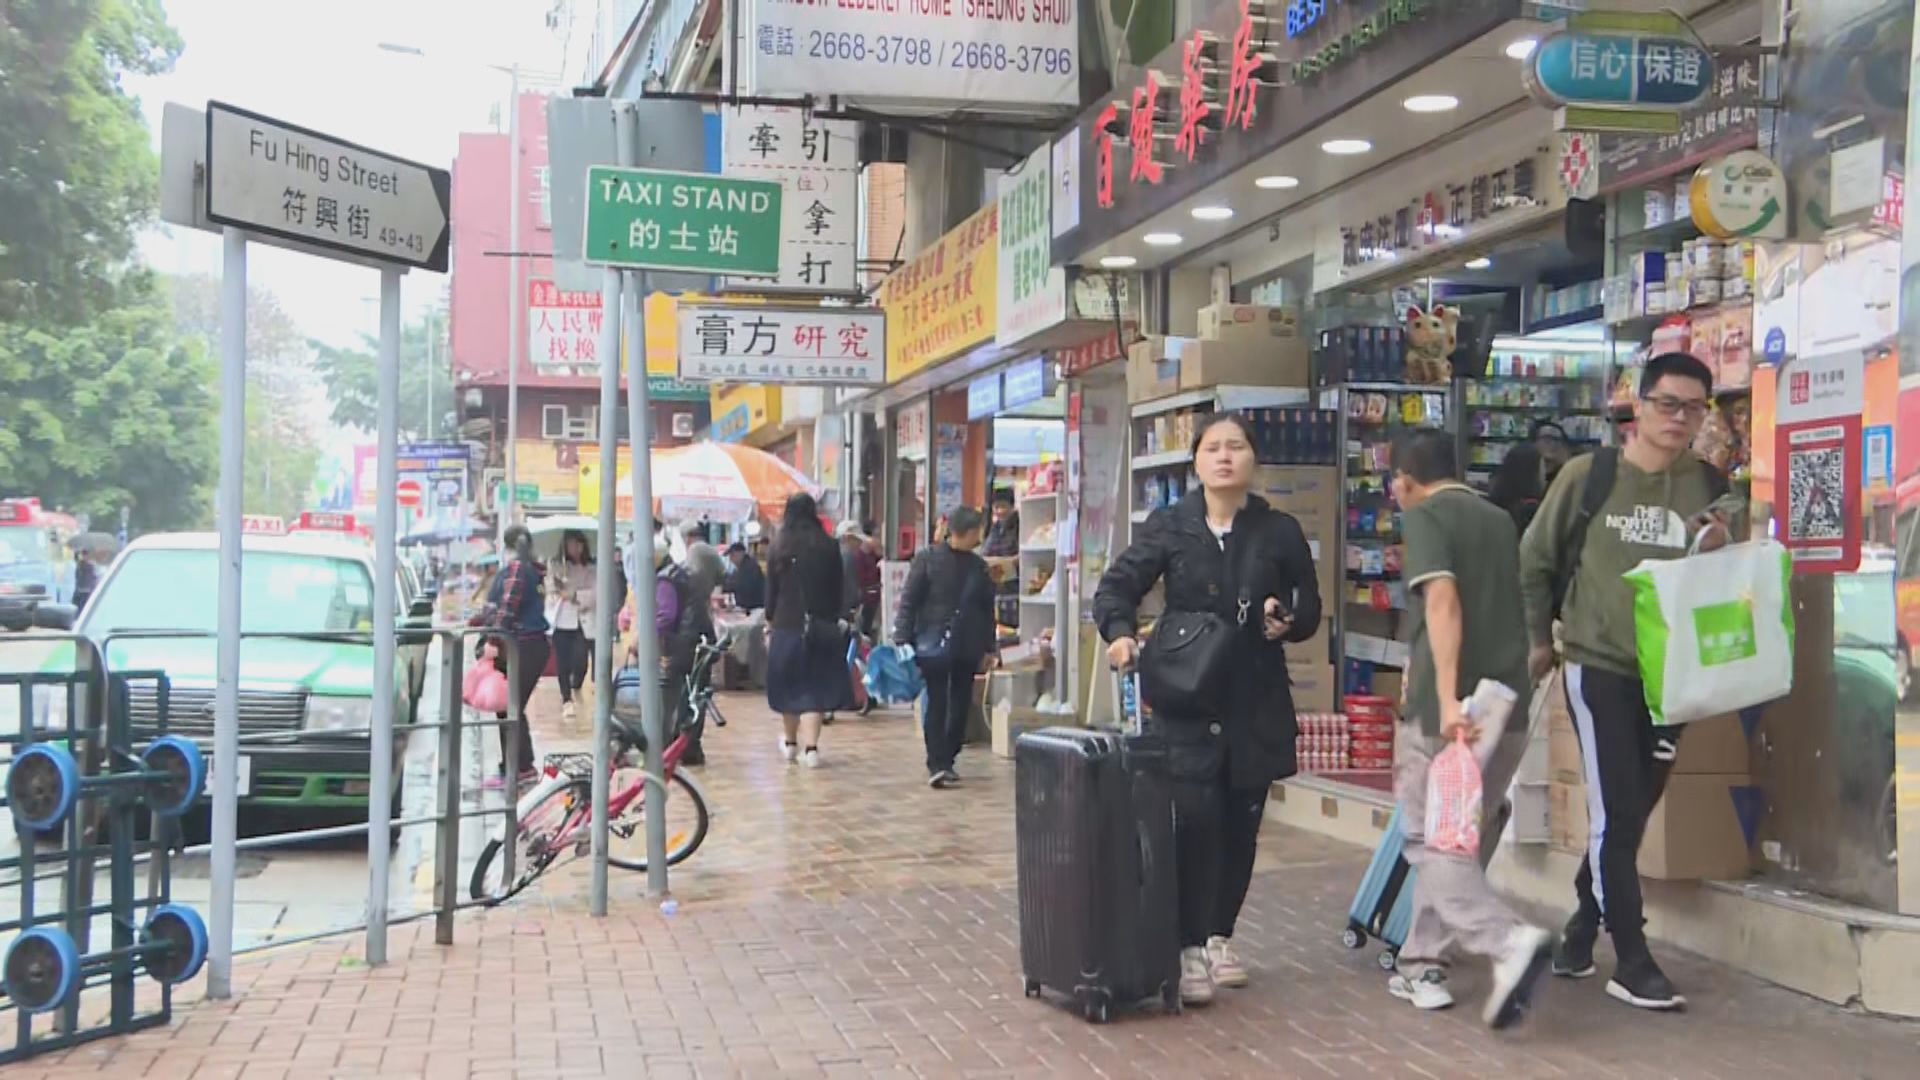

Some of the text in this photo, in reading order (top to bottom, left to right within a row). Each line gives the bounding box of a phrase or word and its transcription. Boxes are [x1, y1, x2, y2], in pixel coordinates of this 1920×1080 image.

[809, 30, 932, 66] 2668-3798
[952, 42, 1072, 75] 2668-3796
[249, 129, 399, 196] Fu Hing Street
[749, 122, 830, 163] 牽引
[600, 179, 770, 214] TAXI STAND
[282, 187, 424, 254] 符興街 49-43
[629, 218, 739, 257] 的士站
[803, 200, 836, 236] 拿
[798, 252, 832, 284] 打
[549, 338, 596, 360] 找換
[696, 313, 869, 359] 膏方研究
